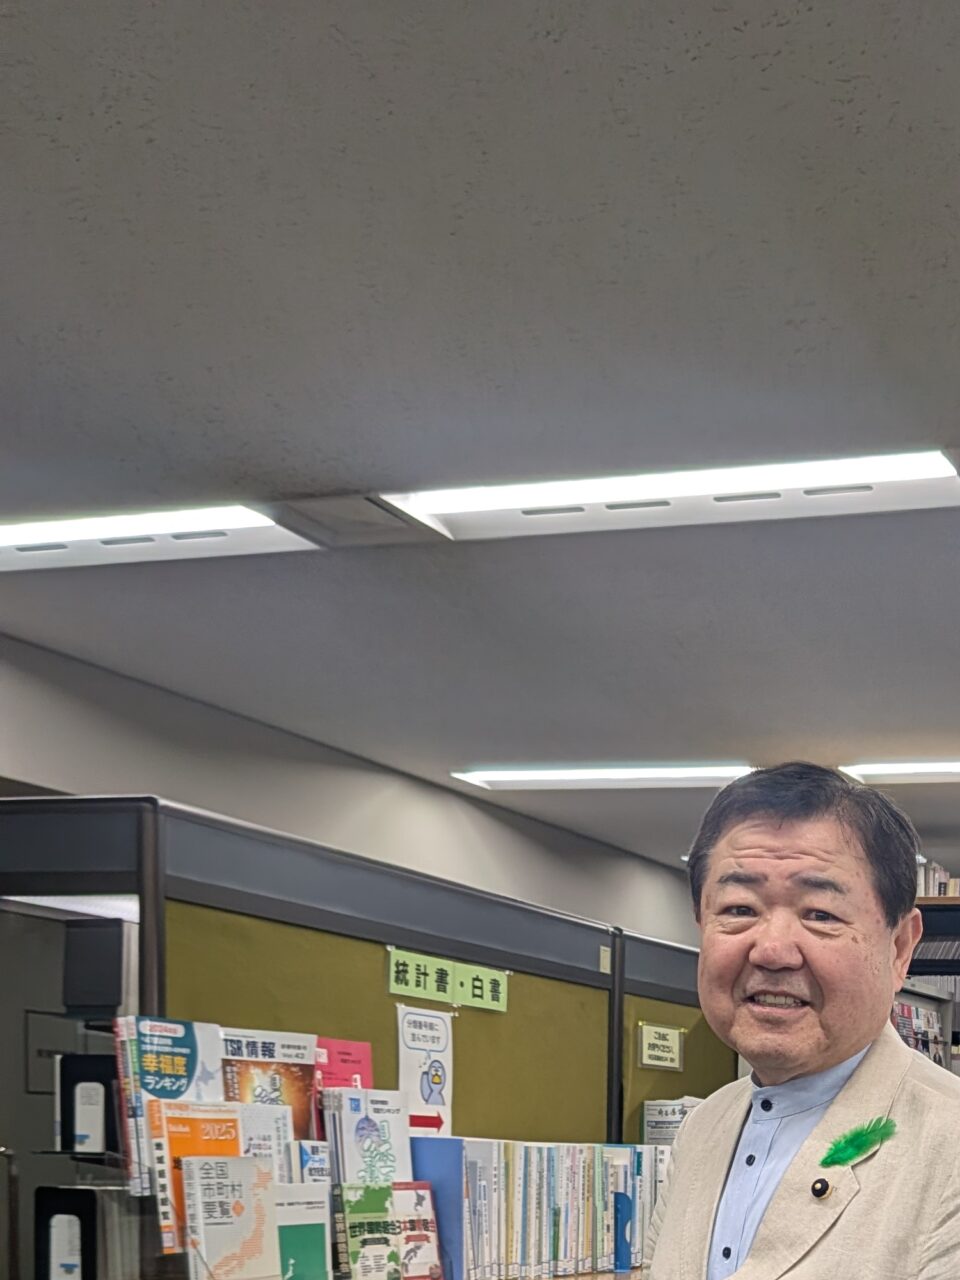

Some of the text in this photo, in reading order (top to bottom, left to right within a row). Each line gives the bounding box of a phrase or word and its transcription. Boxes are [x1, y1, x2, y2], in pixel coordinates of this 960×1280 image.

[394, 960, 502, 1003] 統計書・白書
[142, 1054, 188, 1076] 幸福度
[144, 1076, 188, 1092] ランキング
[201, 1122, 236, 1140] 2025
[200, 1162, 228, 1180] 全国
[202, 1182, 243, 1199] 市町村
[203, 1201, 233, 1219] 要覧
